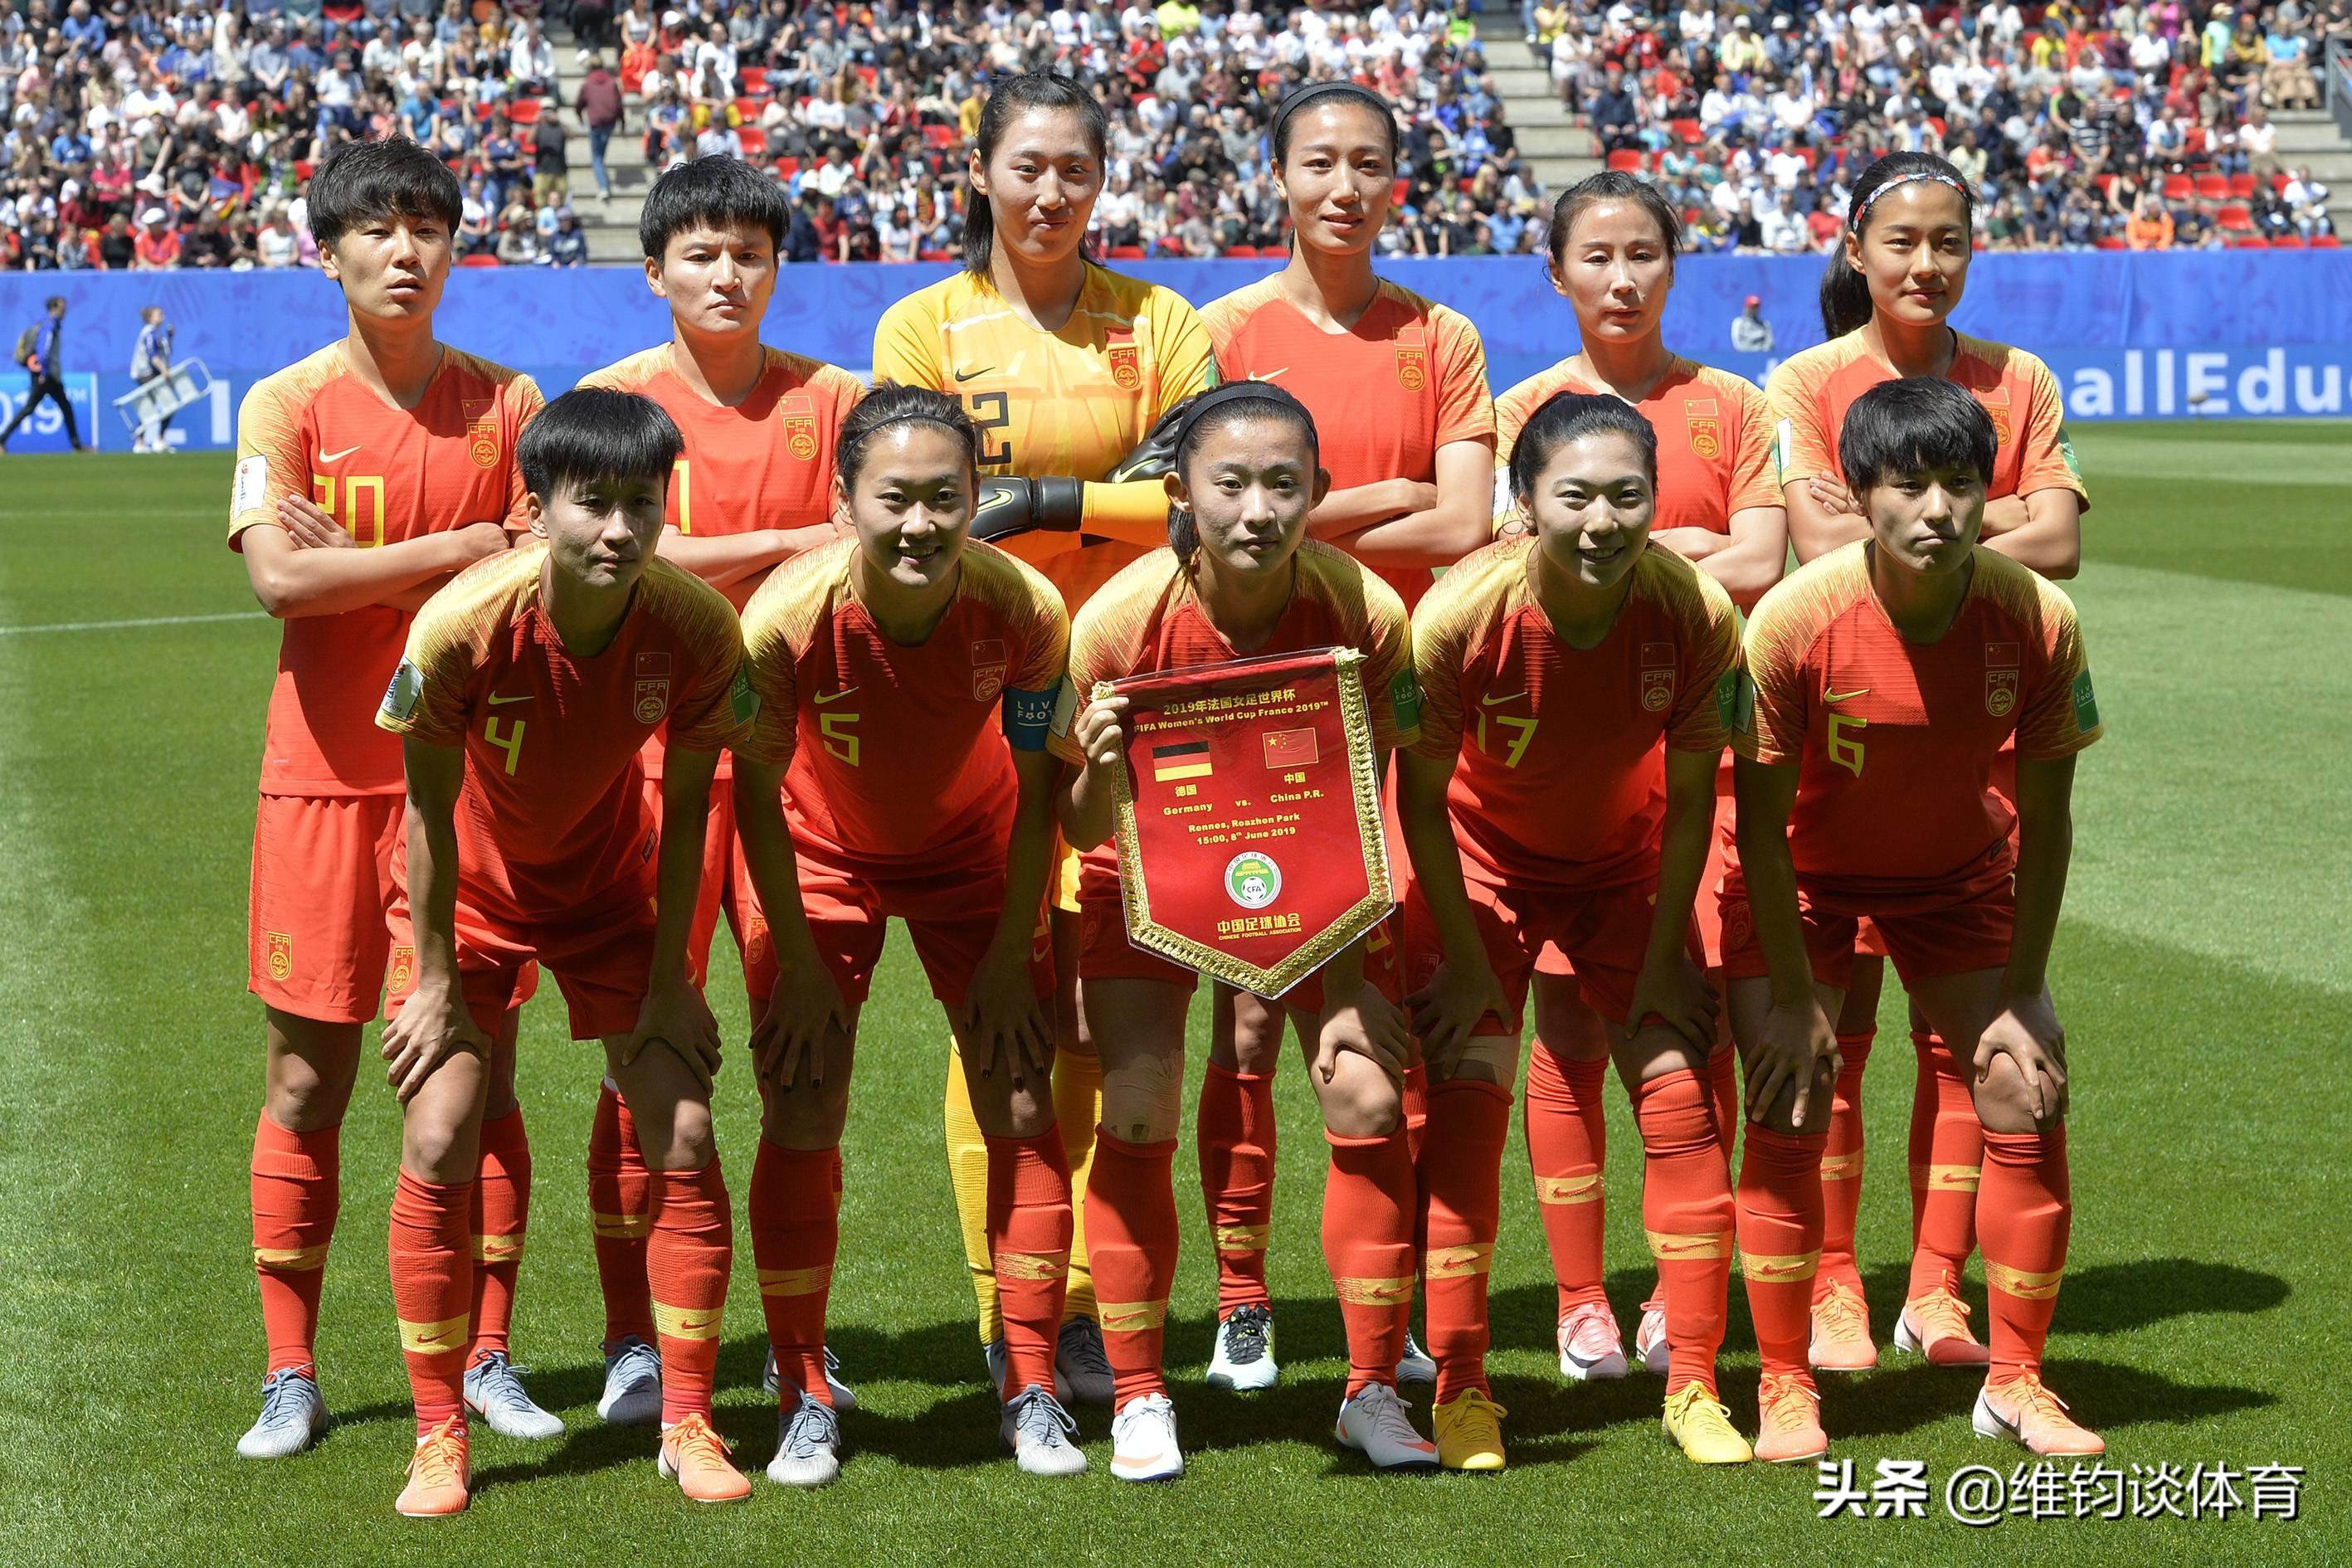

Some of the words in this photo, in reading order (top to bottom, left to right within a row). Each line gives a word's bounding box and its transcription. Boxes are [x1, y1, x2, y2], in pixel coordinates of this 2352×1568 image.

[1109, 349, 1136, 359] CFA
[1398, 351, 1423, 359] CFA
[2052, 348, 2352, 415] allEdu
[470, 425, 495, 434] CFA
[786, 419, 812, 429] CFA
[946, 390, 1011, 465] 2
[1690, 420, 1715, 429] CFA
[1644, 673, 1672, 683] CFA
[1989, 673, 2015, 683] CFA
[638, 682, 665, 691] CFA
[1163, 688, 1296, 715] 2019年法国女足世界杯
[1133, 722, 1157, 733] FIFA
[1158, 717, 1203, 730] Women's
[1205, 712, 1234, 724] World
[1236, 709, 1256, 721] Cup
[1258, 705, 1293, 717] France
[820, 713, 859, 767] 5
[1476, 706, 1539, 768] 17
[485, 717, 525, 776] 4
[1829, 713, 1867, 778] 6
[1283, 772, 1306, 784] 中国
[1163, 802, 1213, 816] Germany
[1235, 799, 1251, 807] vs.
[1270, 791, 1302, 803] China
[1303, 789, 1324, 799] P.R.
[1188, 821, 1230, 833] Rennes,
[1231, 816, 1275, 828] Roazhon
[1276, 812, 1301, 823] Park
[1196, 834, 1229, 845] 15:00,
[1244, 830, 1269, 840] June
[1271, 826, 1296, 837] 2019
[1247, 885, 1262, 894] CFA
[1216, 912, 1301, 934] 中国足球协会
[1242, 930, 1268, 939] FOOTBALL
[1269, 927, 1303, 936] ASSOCIATION
[269, 935, 290, 946] CFA
[396, 948, 412, 958] CFA
